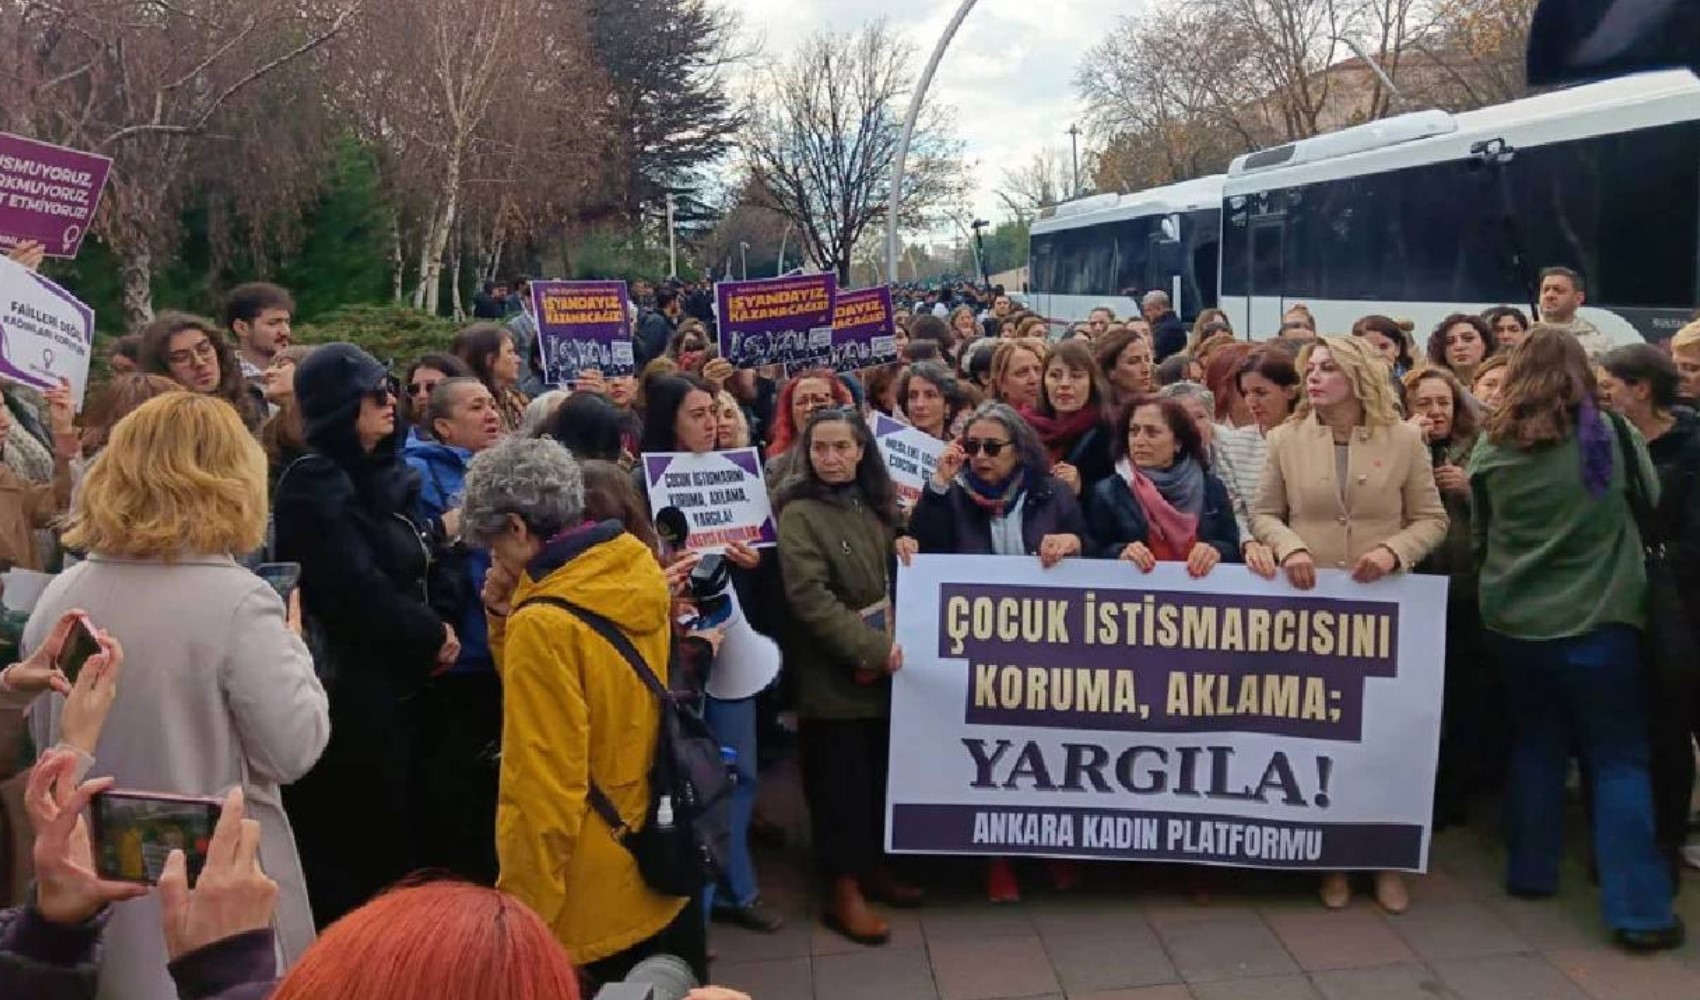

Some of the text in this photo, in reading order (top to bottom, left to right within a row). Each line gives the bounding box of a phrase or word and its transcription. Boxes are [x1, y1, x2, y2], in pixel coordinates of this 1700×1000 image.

[835, 300, 885, 318] DAYIZ,
[947, 593, 1392, 659] ÇOCUK İSTİSMARCISINI
[974, 664, 1342, 723] KORUMA, AKLAMA;
[960, 738, 1333, 808] YARGILA!
[972, 811, 1323, 861] ANKARA KADIN PLATFORMU
